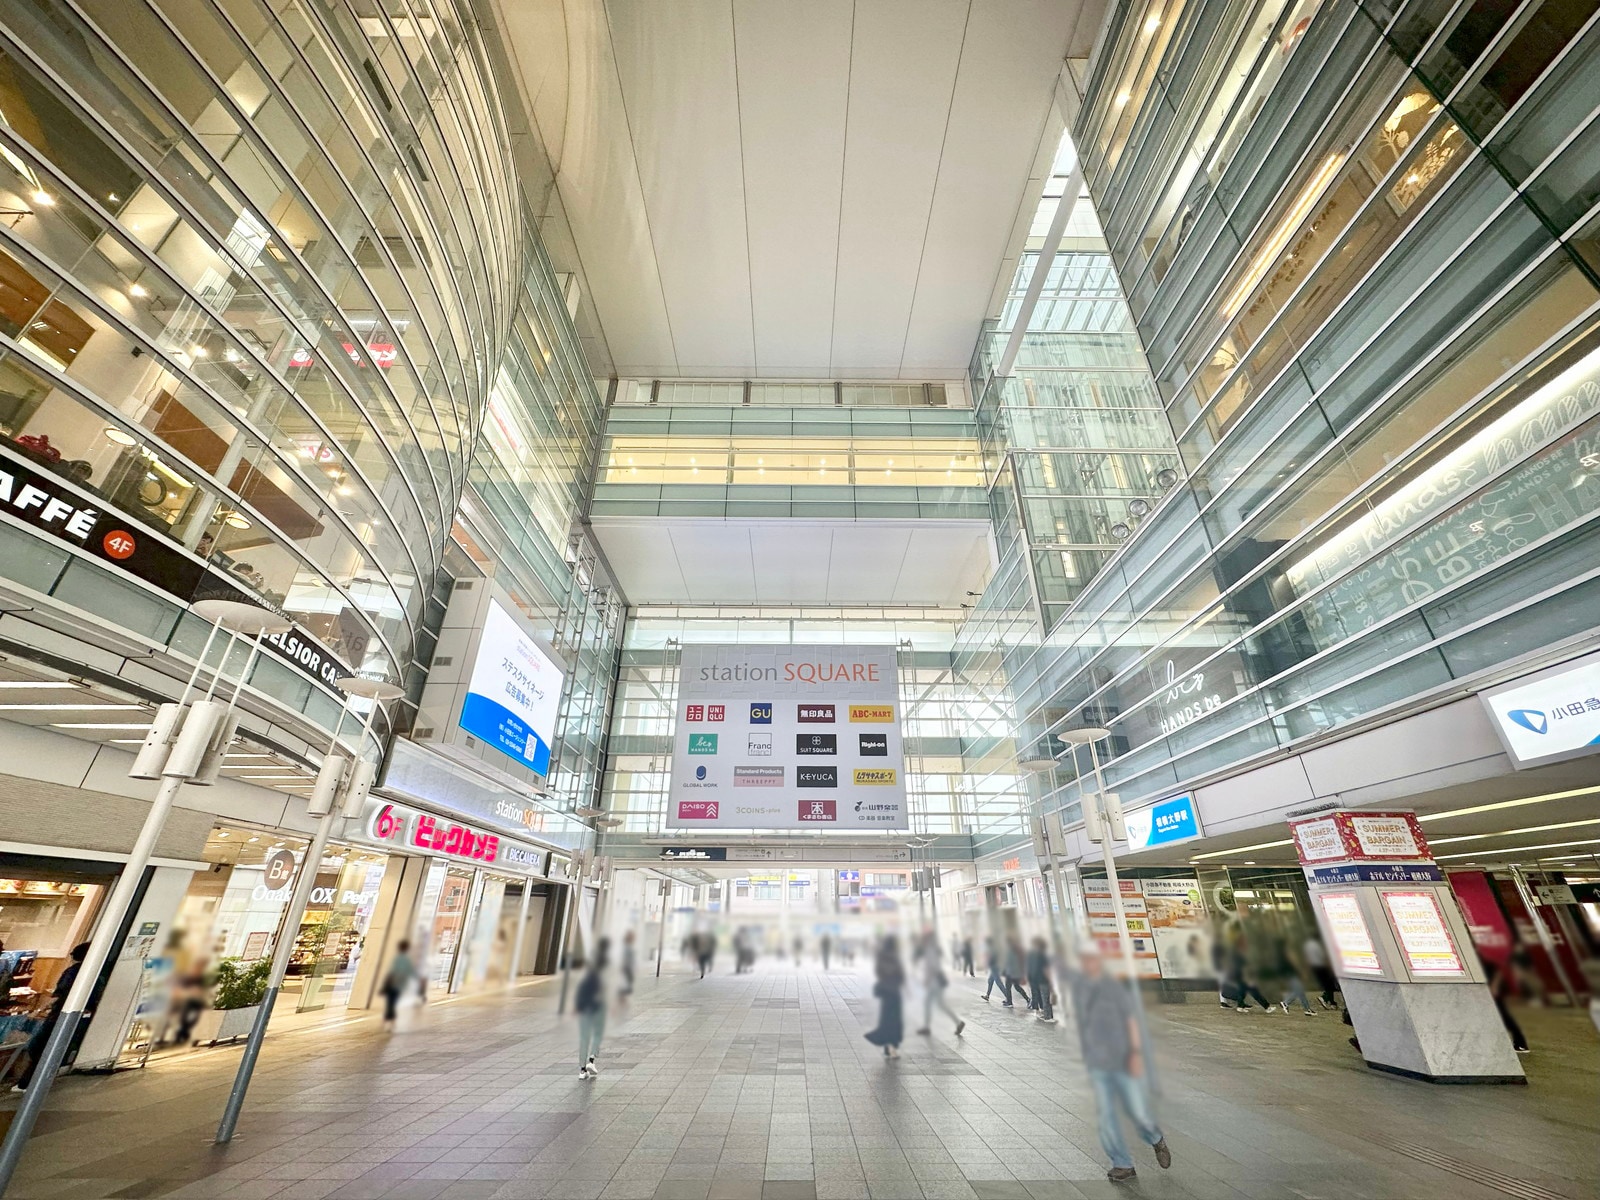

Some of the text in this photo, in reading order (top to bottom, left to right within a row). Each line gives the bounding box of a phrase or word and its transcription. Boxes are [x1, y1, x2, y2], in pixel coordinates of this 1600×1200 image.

[108, 537, 133, 553] 4F
[700, 662, 880, 684] station SQUARE
[688, 706, 702, 720] ユニクロ
[709, 706, 723, 720] UNIQLO
[751, 708, 771, 719] GU
[800, 709, 833, 718] 無印良品
[852, 709, 891, 718] ABC-MART
[1160, 694, 1222, 735] HANDS be
[1551, 697, 1600, 720] 小田急
[861, 741, 885, 749] Right-on
[800, 773, 834, 781] KEYUCA
[856, 771, 893, 780] ムラサキスポーツ
[495, 799, 524, 824] station
[377, 803, 404, 840] 6F
[1362, 824, 1402, 833] SUMMER
[414, 815, 500, 863] ビックカメラ
[1366, 836, 1406, 845] BARGAIN
[509, 848, 541, 867] BIC CAMERA
[310, 887, 337, 903] OX
[1396, 911, 1435, 920] SUMMER
[1403, 924, 1439, 933] BARGAIN
